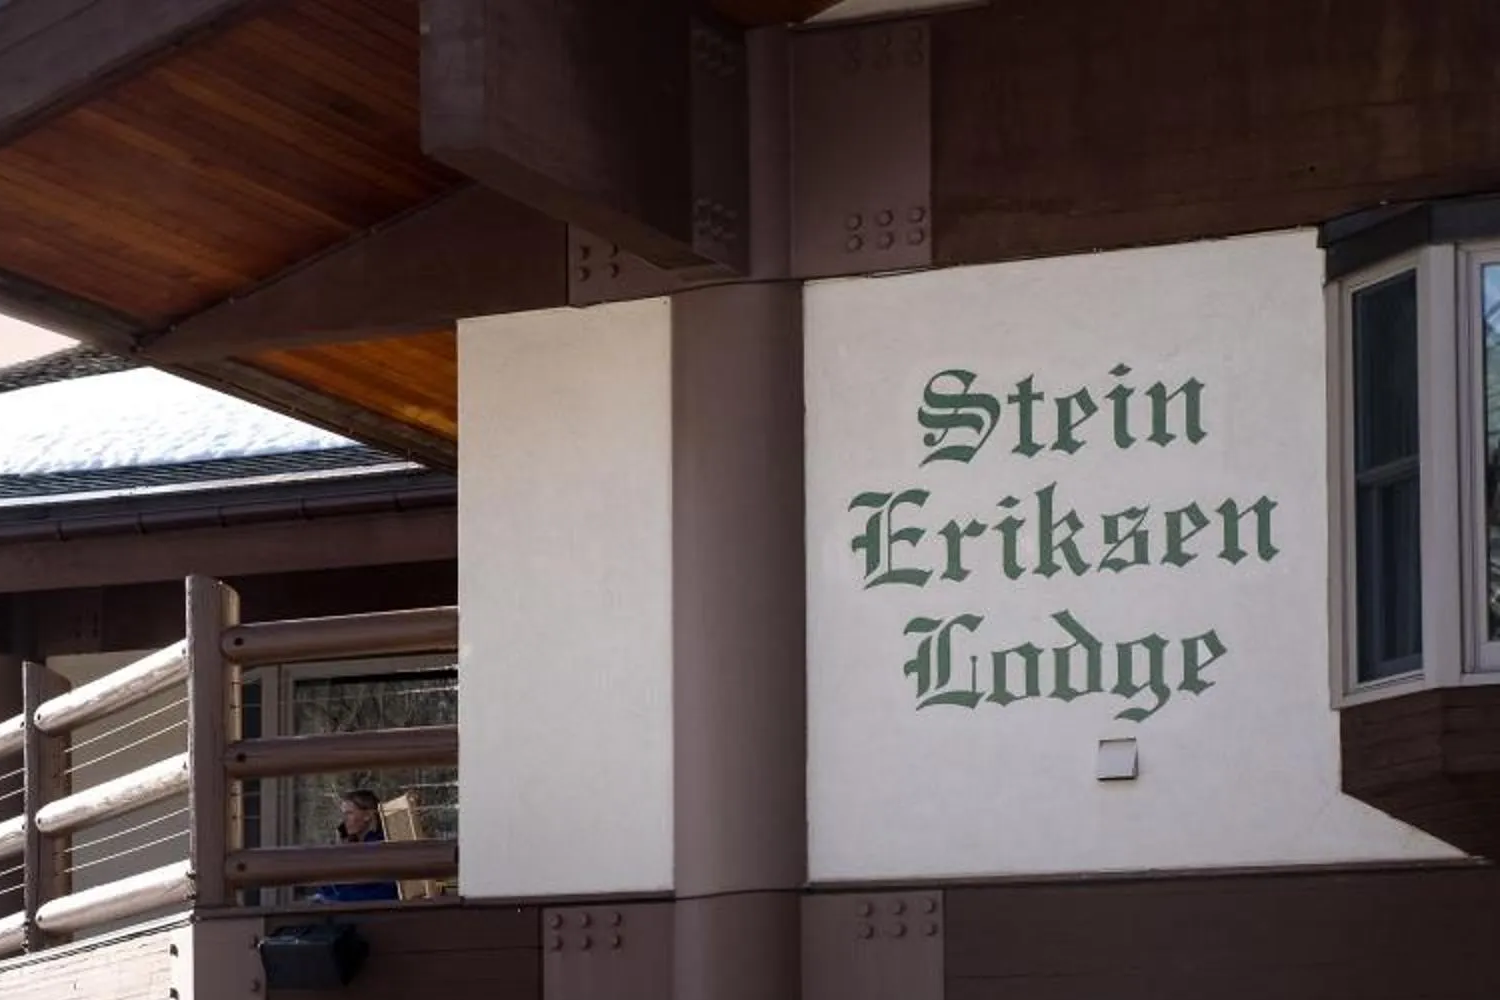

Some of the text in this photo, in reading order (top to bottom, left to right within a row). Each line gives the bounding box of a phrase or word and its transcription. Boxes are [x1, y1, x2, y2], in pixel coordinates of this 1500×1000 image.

[917, 363, 1208, 468] Stein
[847, 481, 1281, 591] Eriksen
[903, 609, 1229, 724] Lodge
